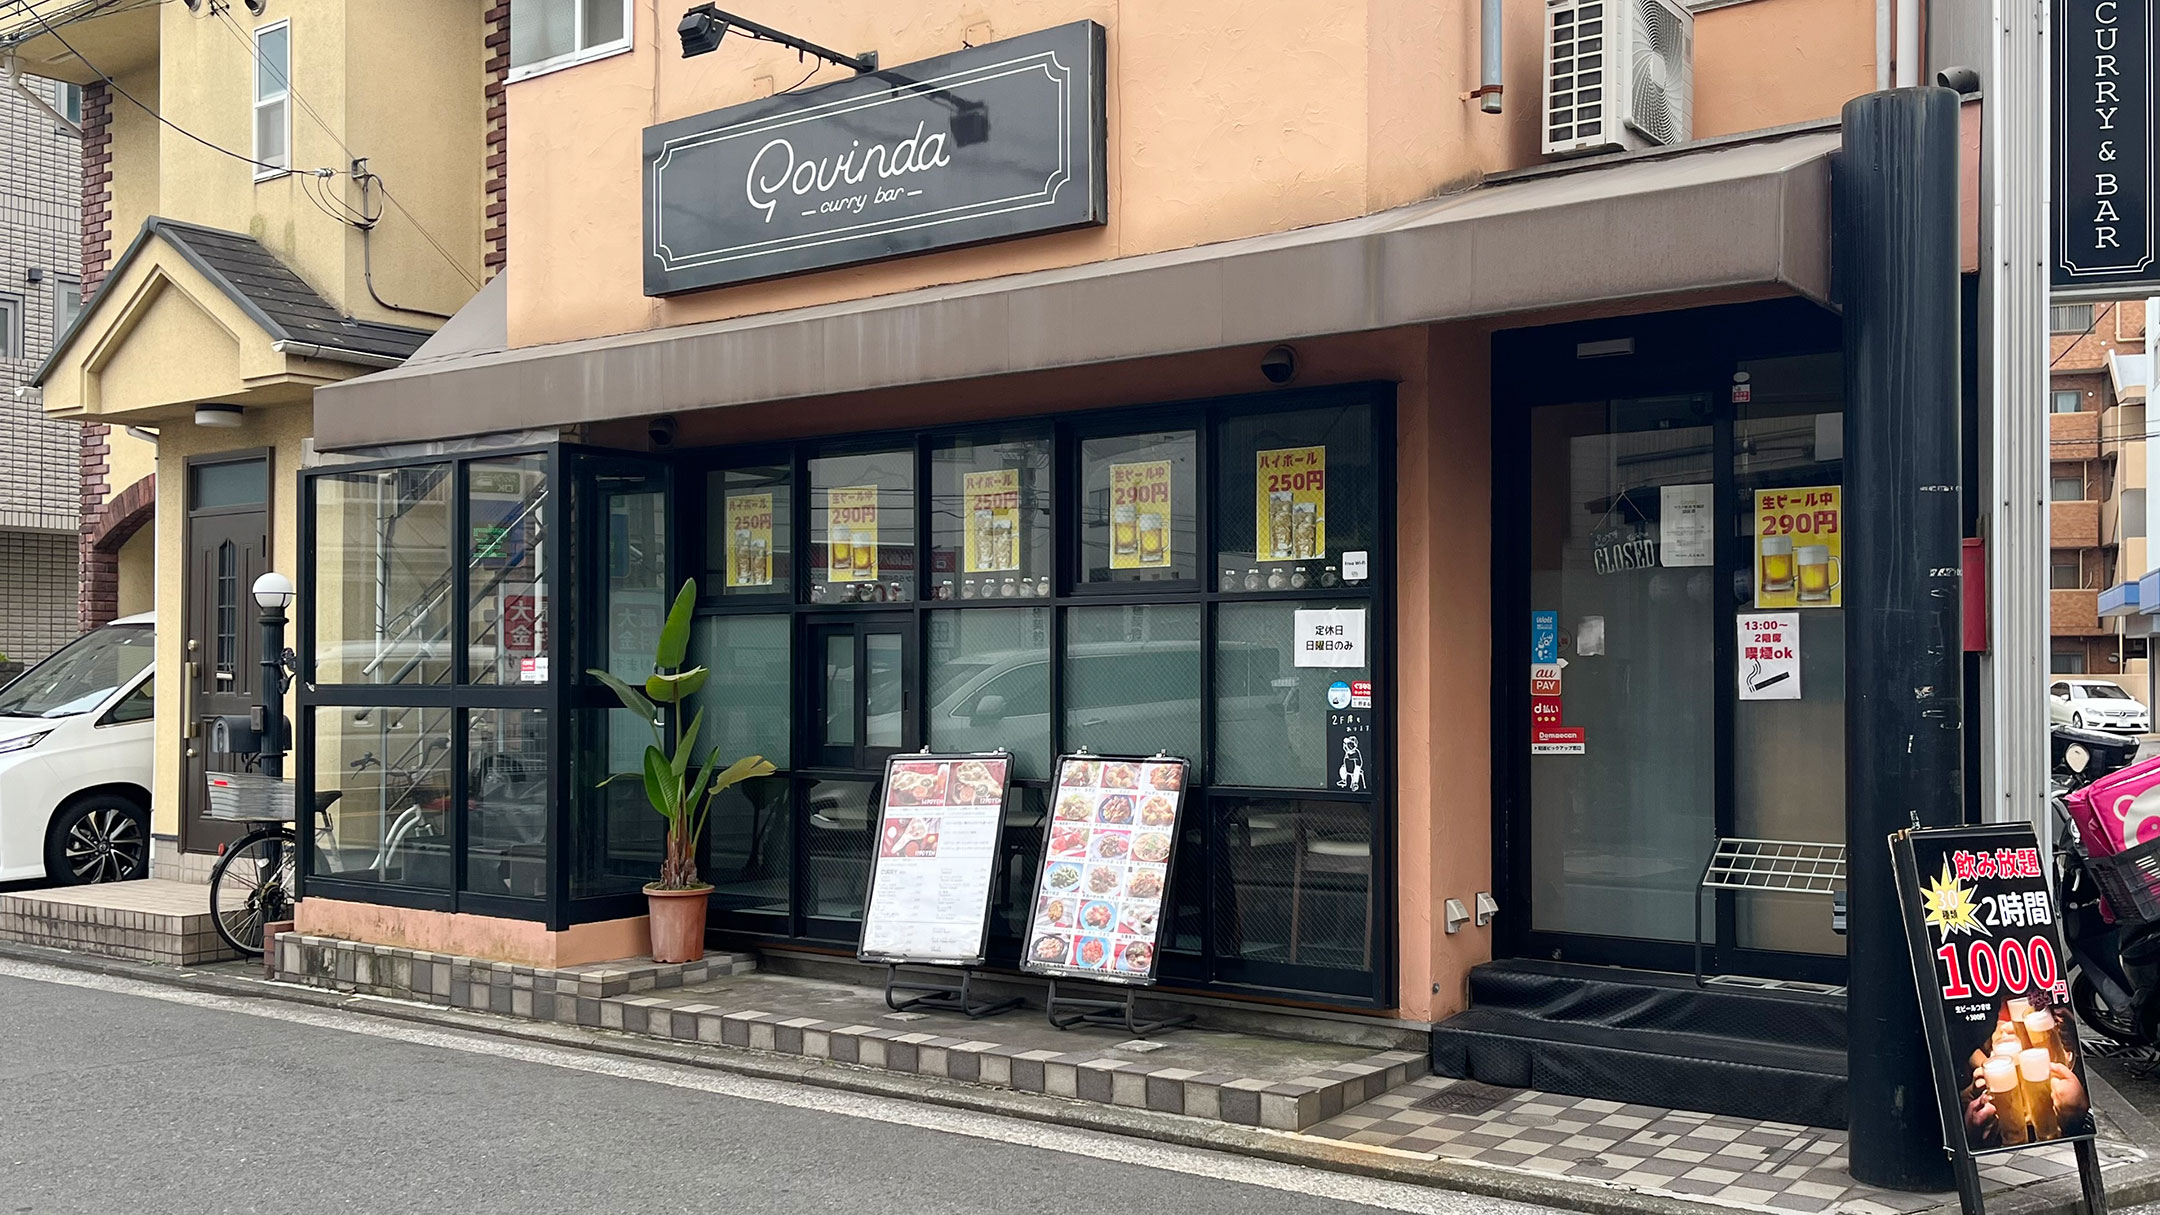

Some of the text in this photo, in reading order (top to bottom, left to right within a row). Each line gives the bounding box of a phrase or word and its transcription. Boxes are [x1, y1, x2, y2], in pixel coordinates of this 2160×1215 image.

[2094, 1, 2120, 248] CURRY & BAR
[746, 120, 950, 223] Govinda
[820, 186, 904, 213] curry bar
[1260, 452, 1317, 469] ハイボール
[1268, 470, 1324, 492] 250円
[973, 491, 1018, 510] 250円
[1115, 482, 1168, 505] 290円
[734, 513, 772, 531] 250円
[832, 504, 876, 524] 290円
[1762, 510, 1838, 535] 290円
[1593, 539, 1655, 575] CLOSED
[1315, 625, 1343, 636] 定休日
[1306, 640, 1354, 651] 日曜日のみ
[1745, 646, 1793, 660] 喫煙ok
[1535, 668, 1557, 679] au
[1536, 681, 1556, 690] PAY
[1534, 703, 1559, 714] d払い
[1952, 847, 2042, 882] 飲み放題
[1935, 888, 1959, 911] 30
[1981, 891, 2051, 927] 2時間
[1941, 910, 1959, 920] 種類
